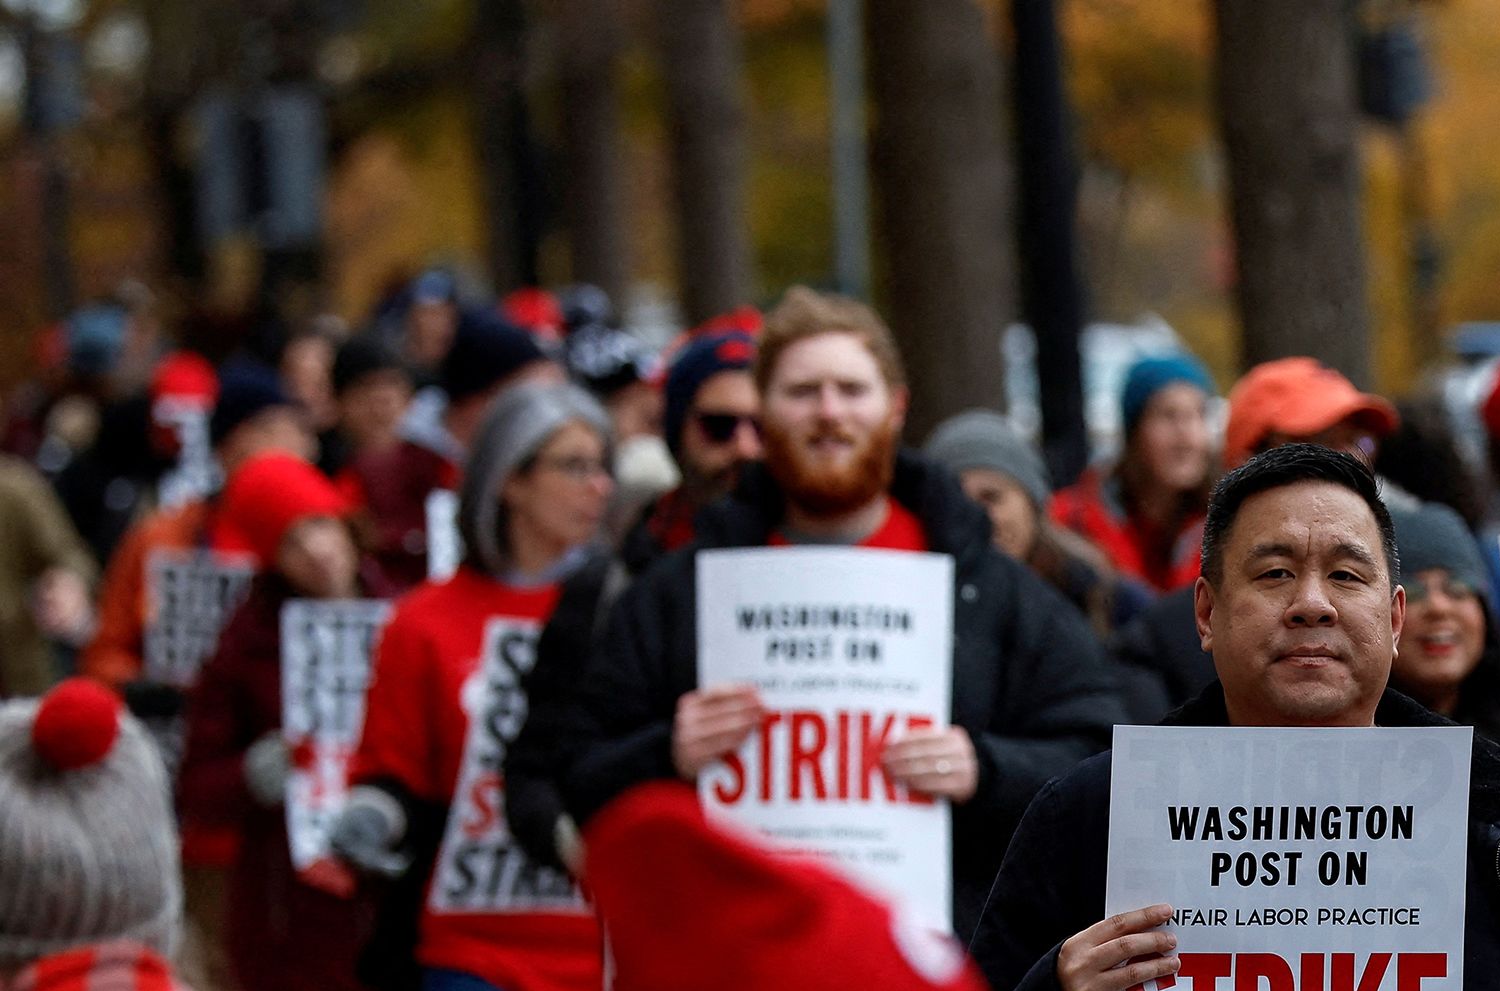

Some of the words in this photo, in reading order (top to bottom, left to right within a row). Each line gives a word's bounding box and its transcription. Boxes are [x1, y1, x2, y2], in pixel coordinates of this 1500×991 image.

[1168, 805, 1414, 841] WASHINGTON
[1210, 851, 1302, 886] POST
[1318, 851, 1367, 886] ON
[1158, 908, 1227, 926] NFAIR
[1236, 908, 1308, 926] LABOR
[1318, 908, 1420, 926] PRACTICE
